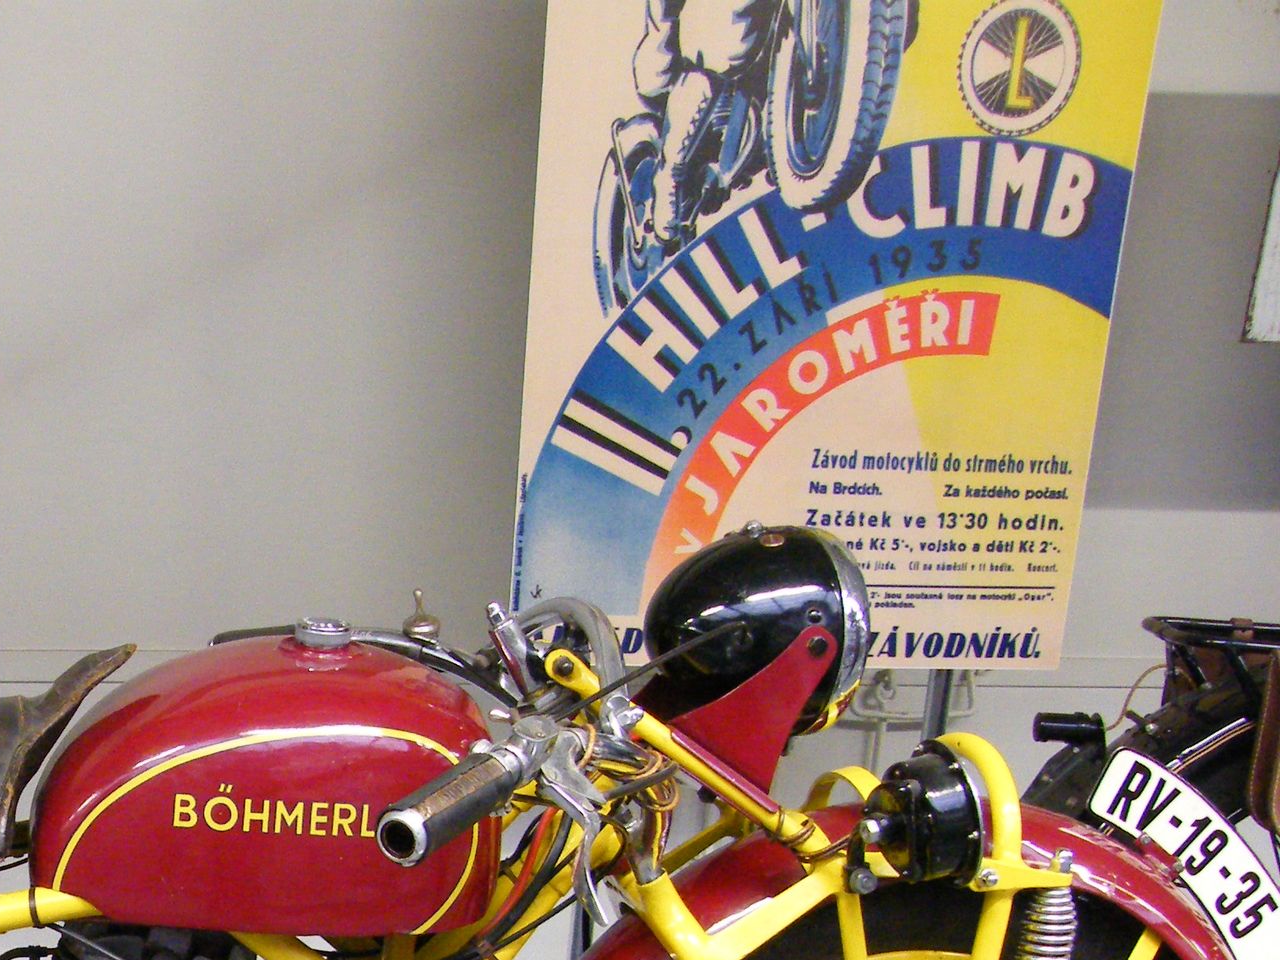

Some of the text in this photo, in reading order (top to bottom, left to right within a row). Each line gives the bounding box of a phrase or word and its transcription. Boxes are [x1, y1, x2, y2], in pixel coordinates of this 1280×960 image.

[869, 239, 983, 285] 1935
[811, 448, 1072, 476] Závod motocyklů do strmého vrchu.
[809, 481, 827, 494] Na
[943, 485, 961, 498] Za
[965, 484, 1020, 499] každého
[805, 508, 892, 528] Začátek
[903, 515, 926, 529] ve
[997, 513, 1065, 532] hodin.
[869, 538, 886, 551] Kč
[919, 539, 967, 554] vojsko
[972, 542, 981, 552] a
[1018, 540, 1035, 553] Kč
[171, 782, 376, 838] BÖHMERL
[1106, 759, 1280, 940] RV-19-35
